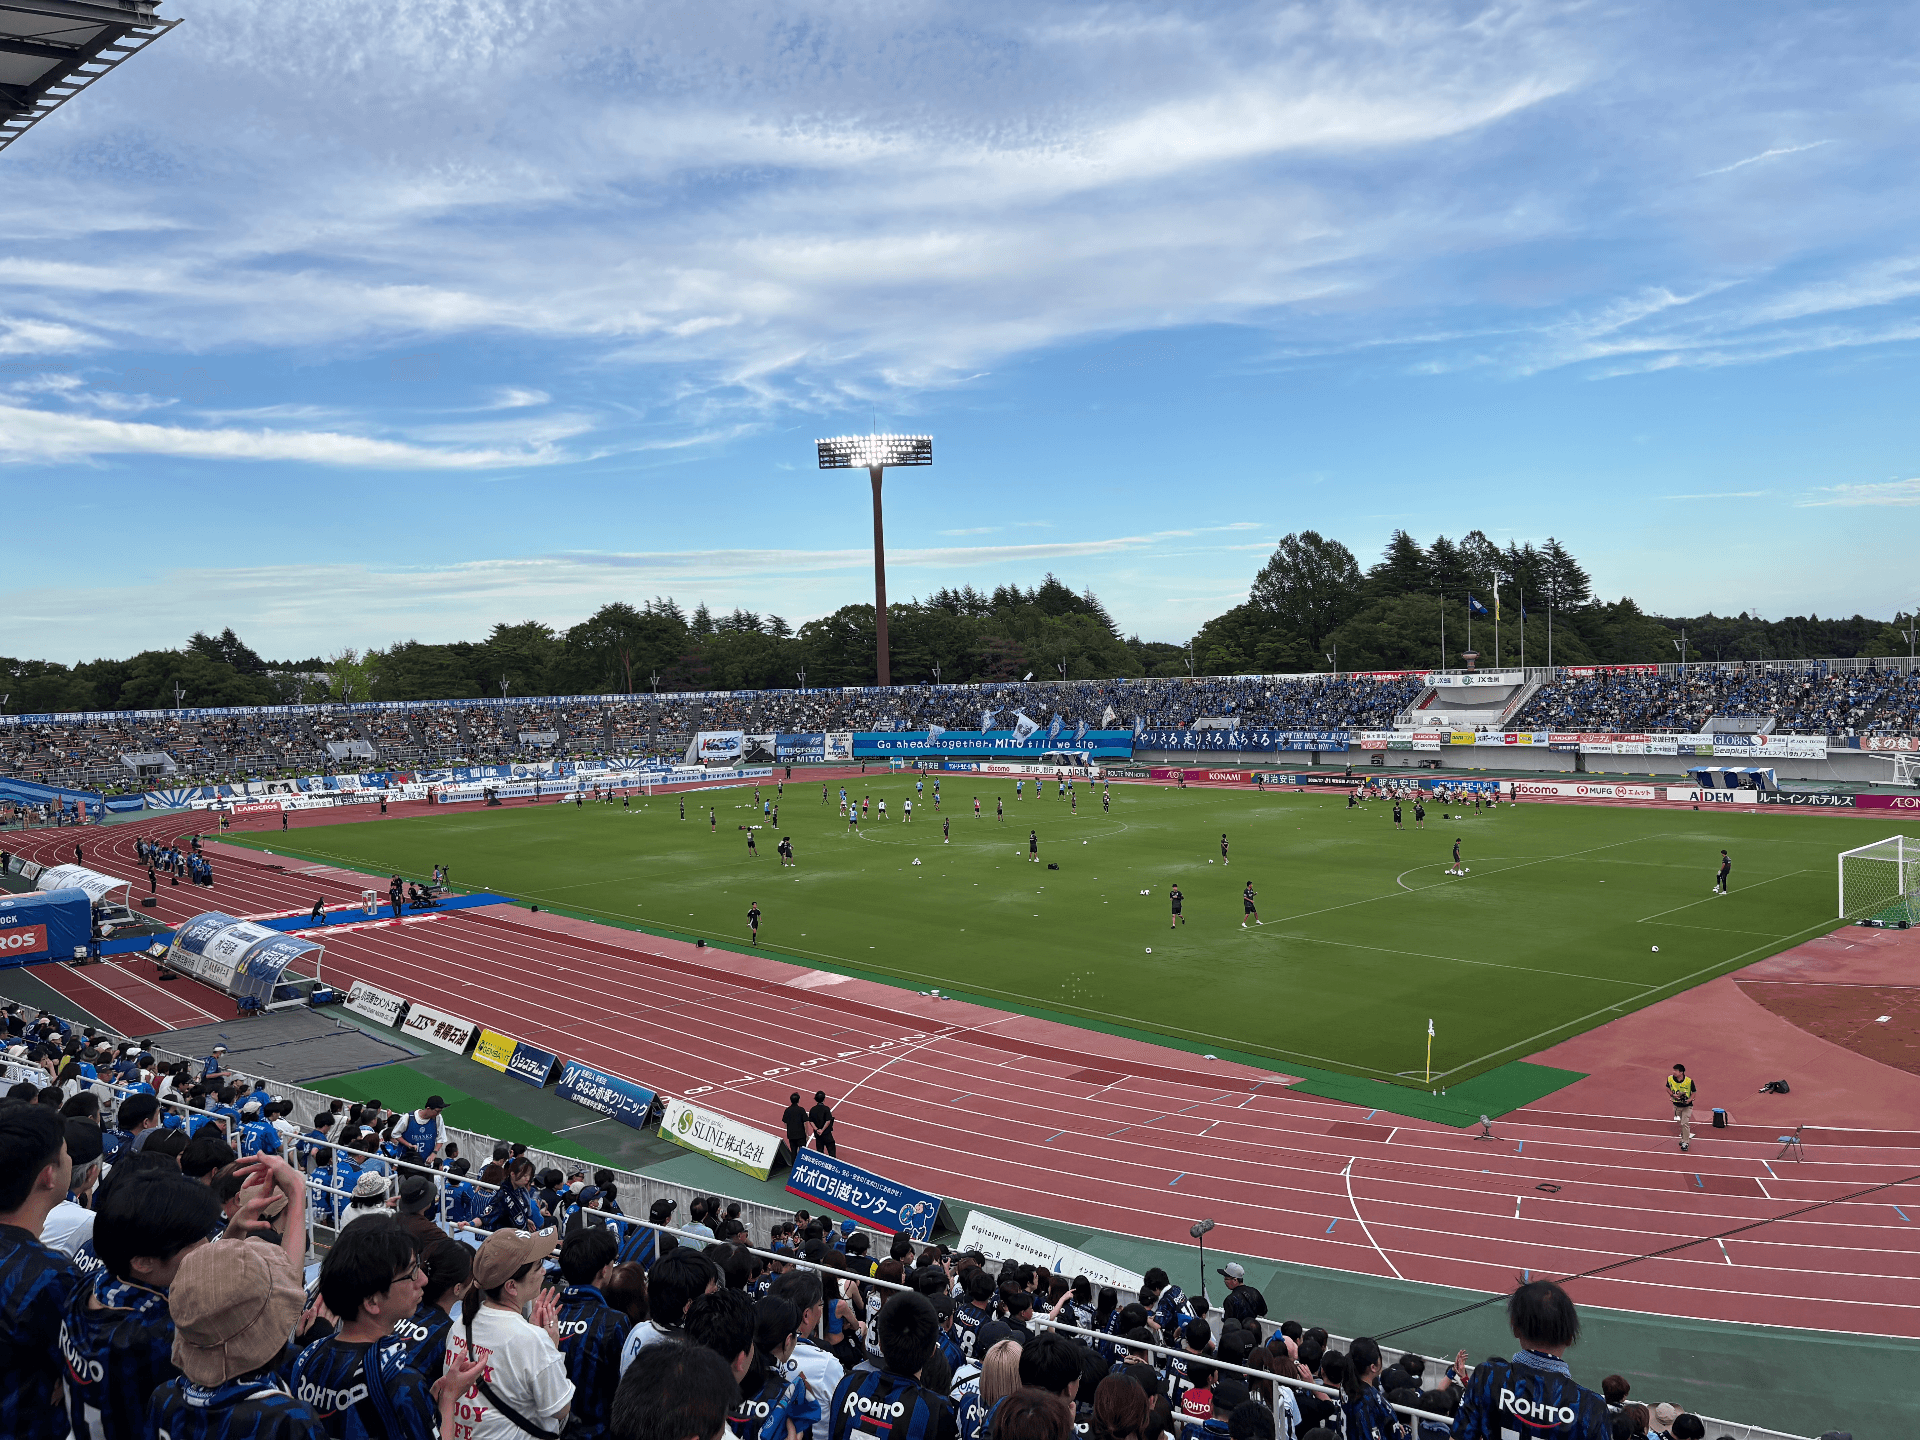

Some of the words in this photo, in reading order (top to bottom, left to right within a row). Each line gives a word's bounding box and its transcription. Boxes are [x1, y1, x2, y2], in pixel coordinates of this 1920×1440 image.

[878, 740, 891, 748] Go
[897, 740, 930, 748] ahead
[995, 739, 1023, 748] MITO
[1028, 740, 1051, 748] till
[1140, 732, 1178, 744] やりきる
[1183, 731, 1223, 746] 走りきる
[1714, 735, 1748, 745] GLOBIS
[1714, 747, 1748, 755] Seaplus
[1209, 773, 1240, 781] KONAMI
[1516, 783, 1558, 794] docomo
[238, 803, 278, 811] LANDCROS
[433, 1021, 469, 1046] 常陽石油
[576, 1078, 648, 1116] みなみ赤塚クリニック
[793, 1165, 897, 1214] ポポロ引越センター
[972, 1224, 1012, 1245] digitalprint
[1015, 1242, 1052, 1260] wallpaper
[1079, 1266, 1108, 1283] インテリアで
[956, 1310, 980, 1326] ROHTO
[59, 1319, 104, 1382] ROHTO
[843, 1391, 904, 1419] ROHTO
[1183, 1397, 1210, 1413] ROHTO
[1499, 1388, 1575, 1424] ROHTO
